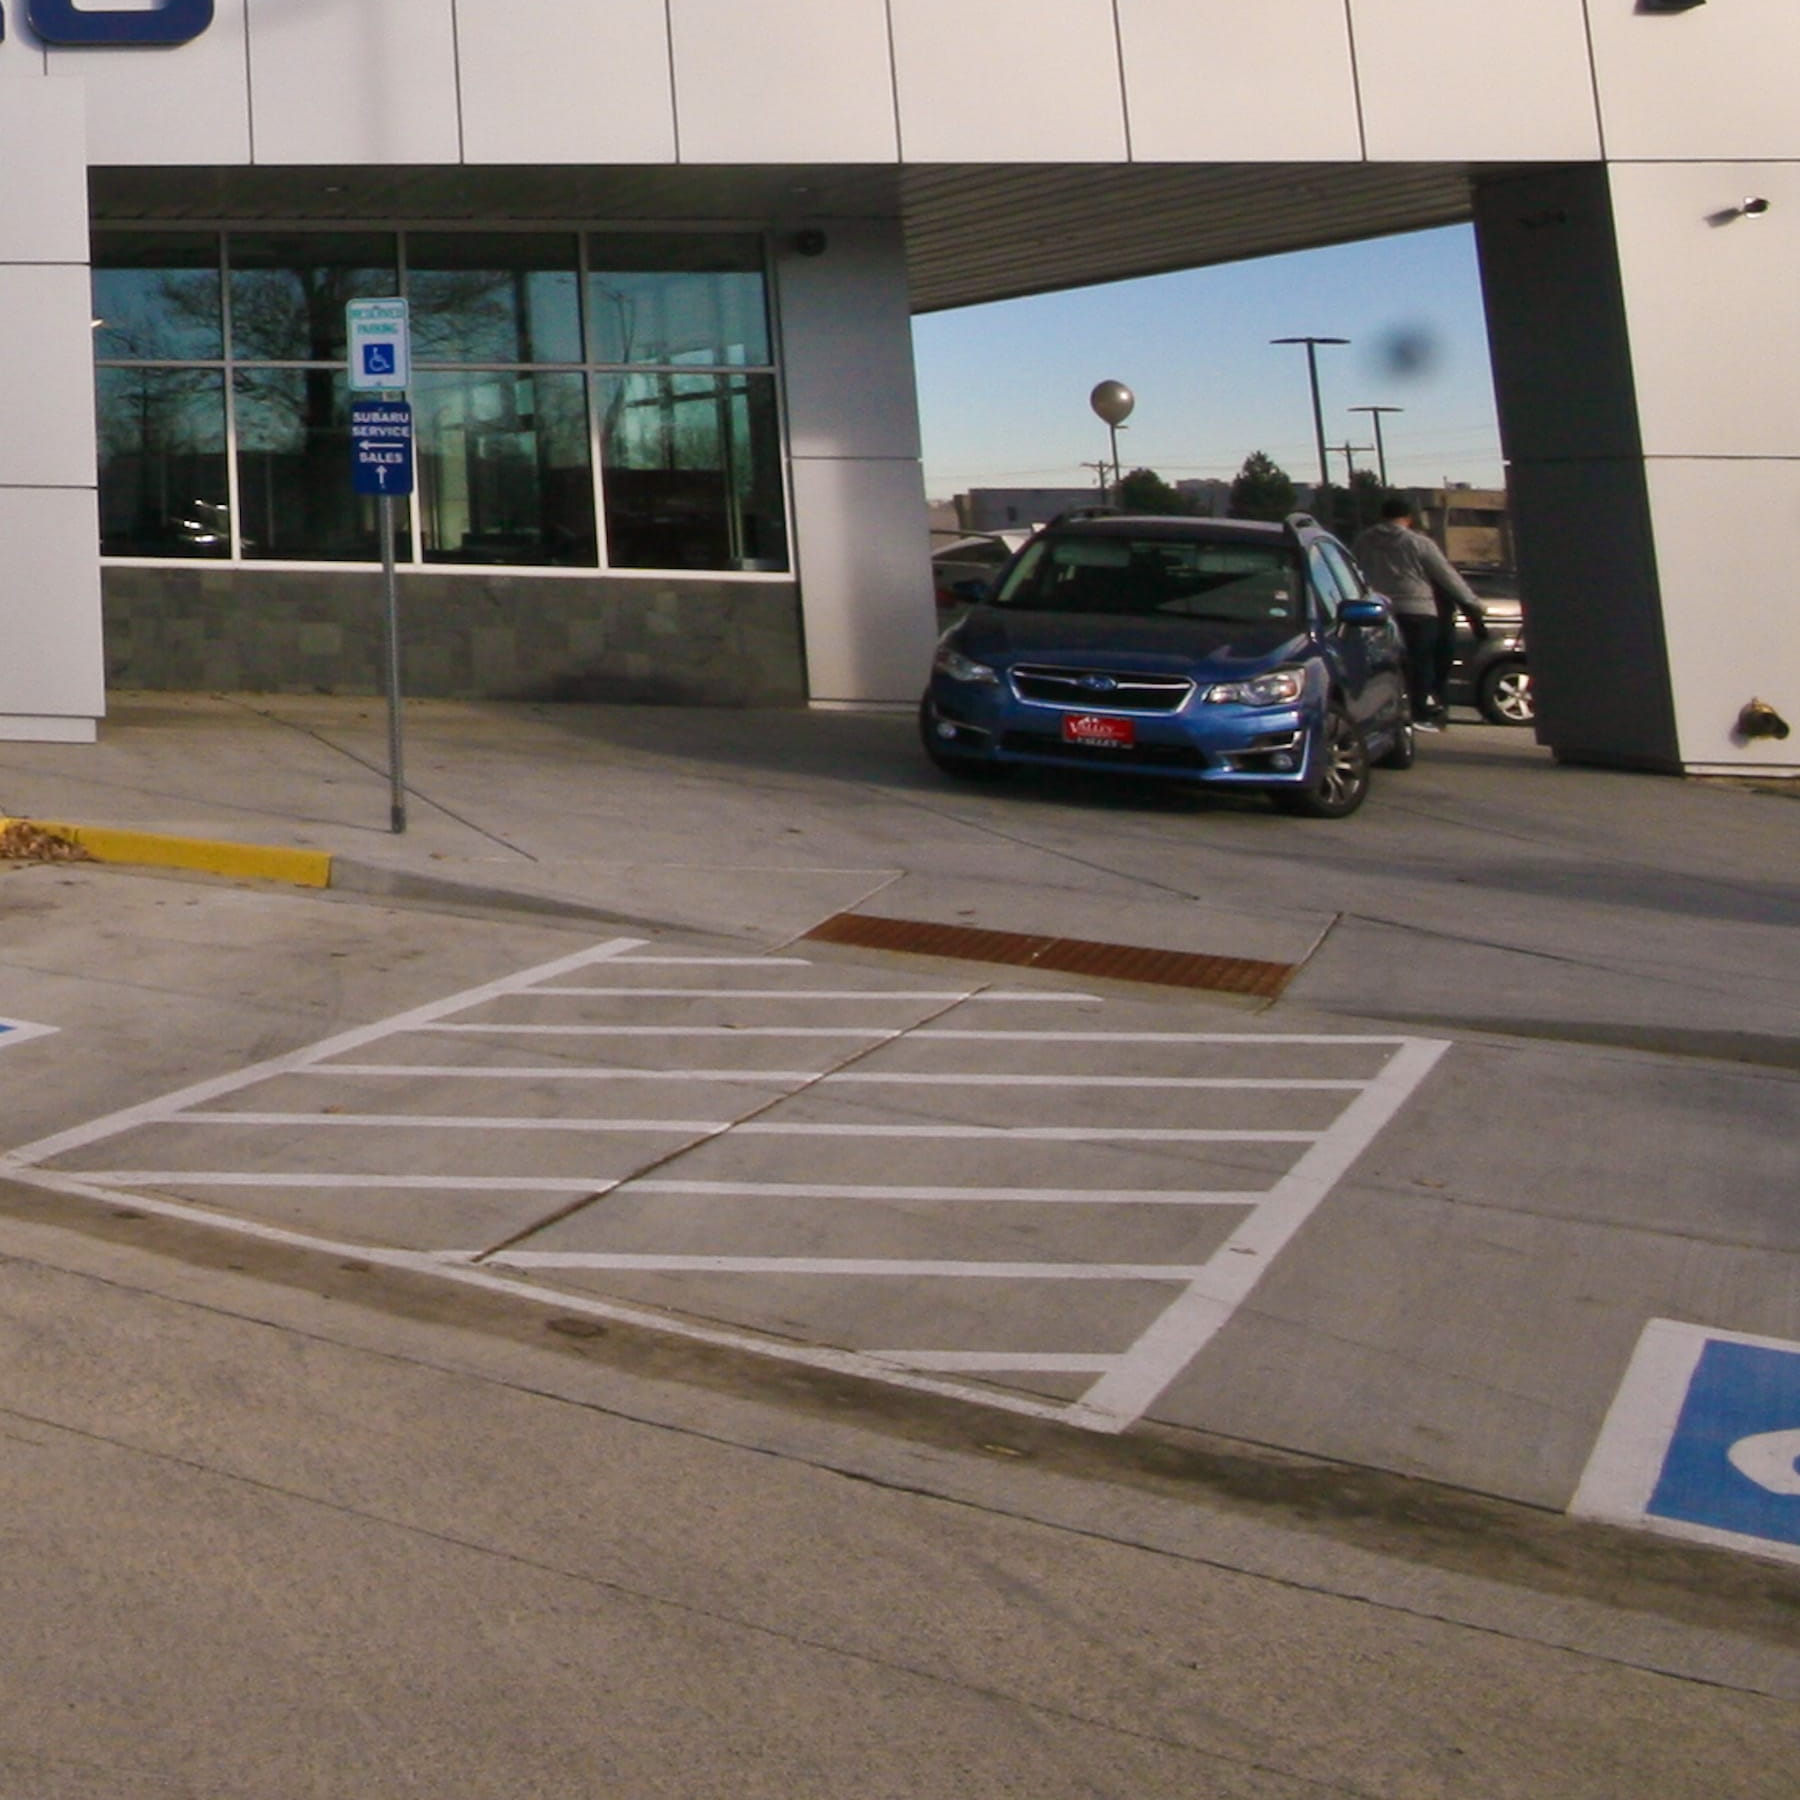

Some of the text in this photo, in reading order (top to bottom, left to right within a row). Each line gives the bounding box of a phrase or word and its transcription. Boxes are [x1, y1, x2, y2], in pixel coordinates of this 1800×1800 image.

[357, 324, 398, 334] PARKING
[353, 411, 409, 423] SUBARU
[352, 426, 410, 438] SERVICE
[359, 453, 403, 464] SALES
